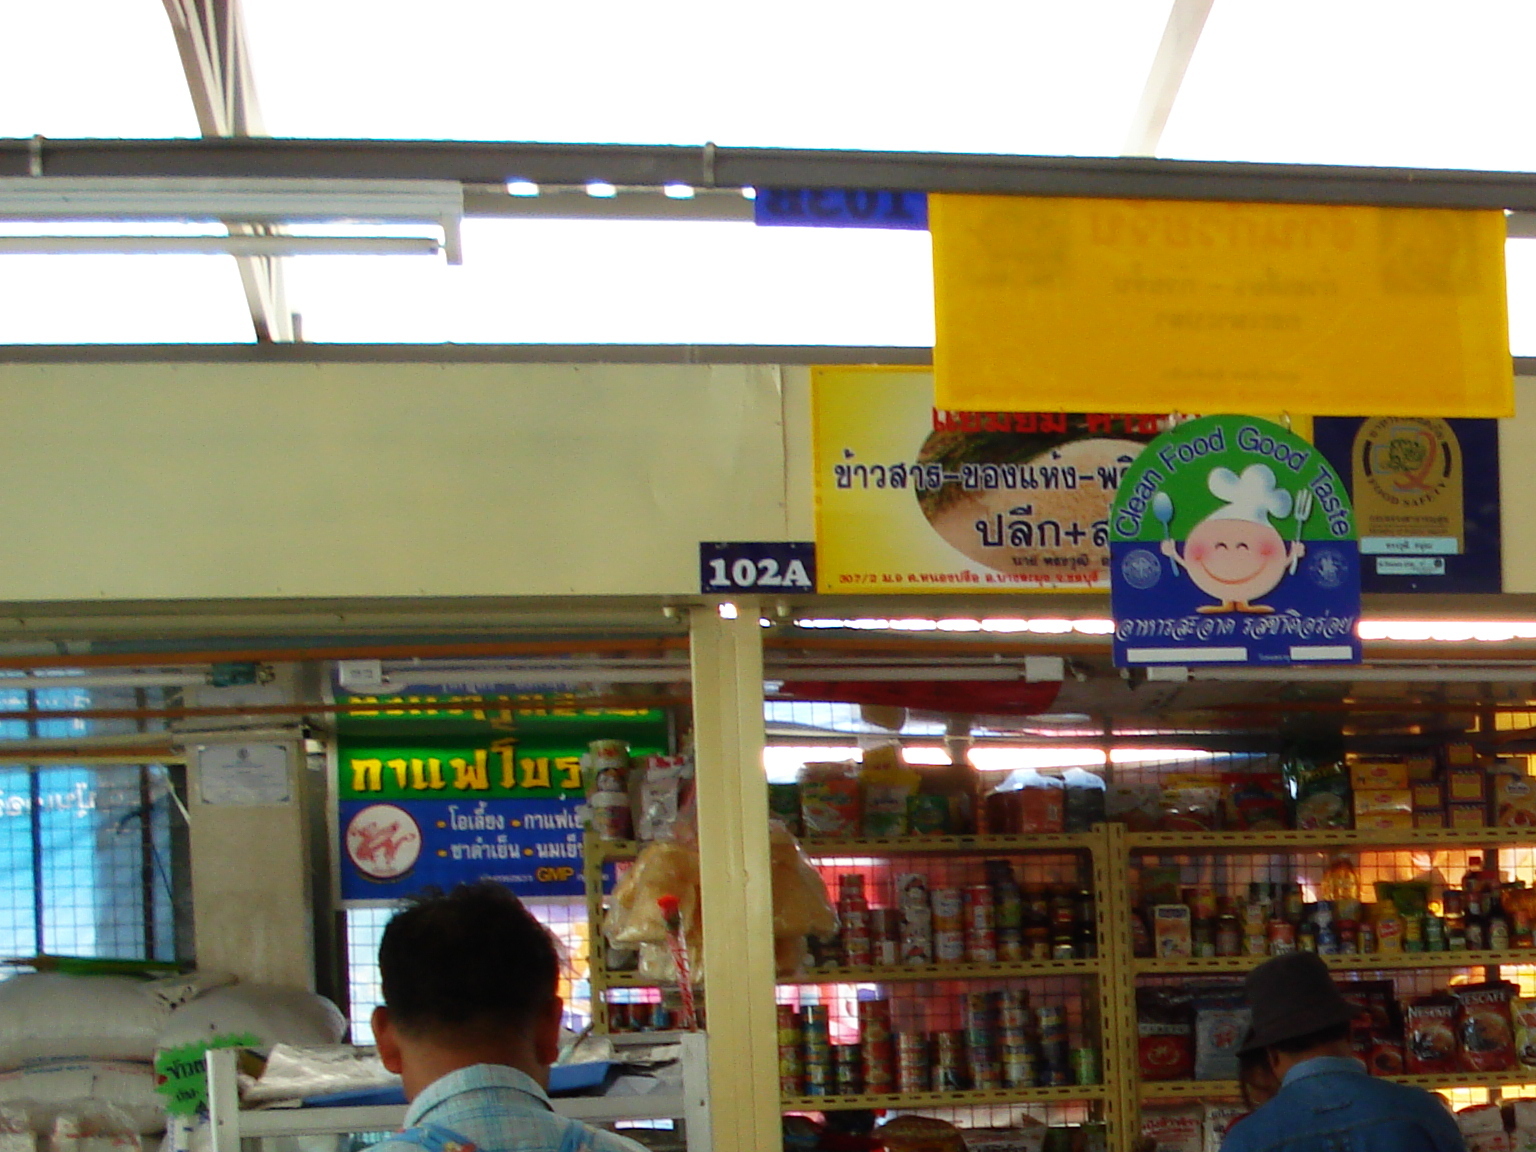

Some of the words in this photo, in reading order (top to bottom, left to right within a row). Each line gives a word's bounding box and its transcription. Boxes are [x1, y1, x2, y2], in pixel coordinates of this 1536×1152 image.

[1115, 467, 1164, 539] Clean
[1158, 427, 1226, 472] Food
[1237, 426, 1311, 472] Good
[1309, 464, 1351, 538] Taste
[709, 558, 813, 587] 102A
[351, 738, 584, 792] กาแฟโบร
[536, 867, 575, 883] GMP
